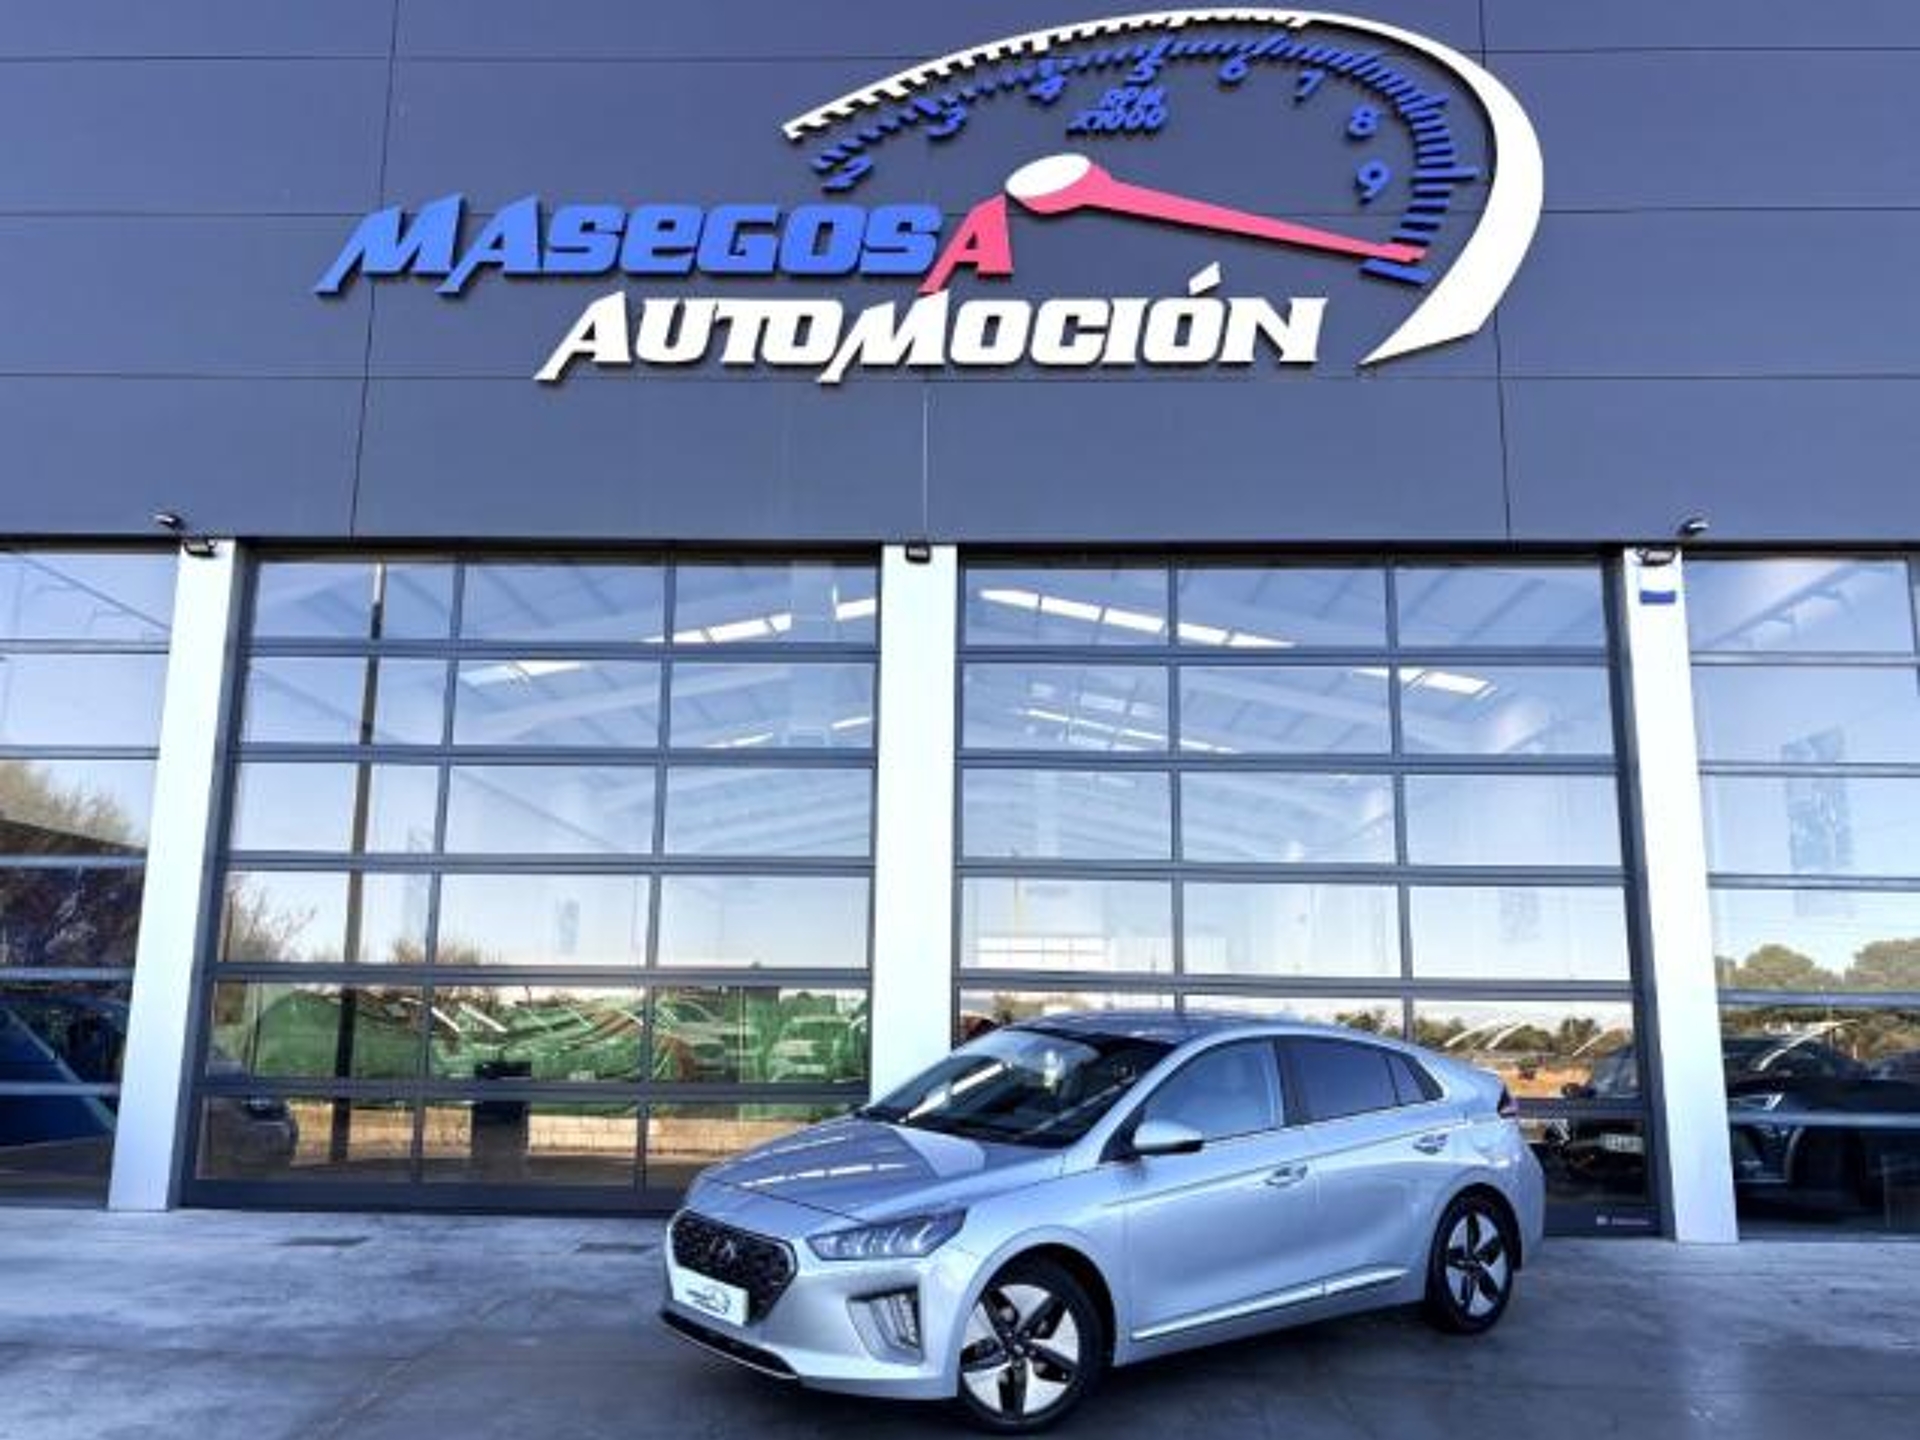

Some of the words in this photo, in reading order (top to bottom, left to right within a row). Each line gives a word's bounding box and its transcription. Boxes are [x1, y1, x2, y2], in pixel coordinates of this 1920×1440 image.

[1219, 56, 1248, 82] 6
[1297, 70, 1325, 100] 7
[1349, 104, 1380, 137] 8
[1356, 160, 1391, 203] 9
[315, 193, 1014, 294] MASEGOSA
[535, 263, 1328, 383] AUTOMOCIÓN
